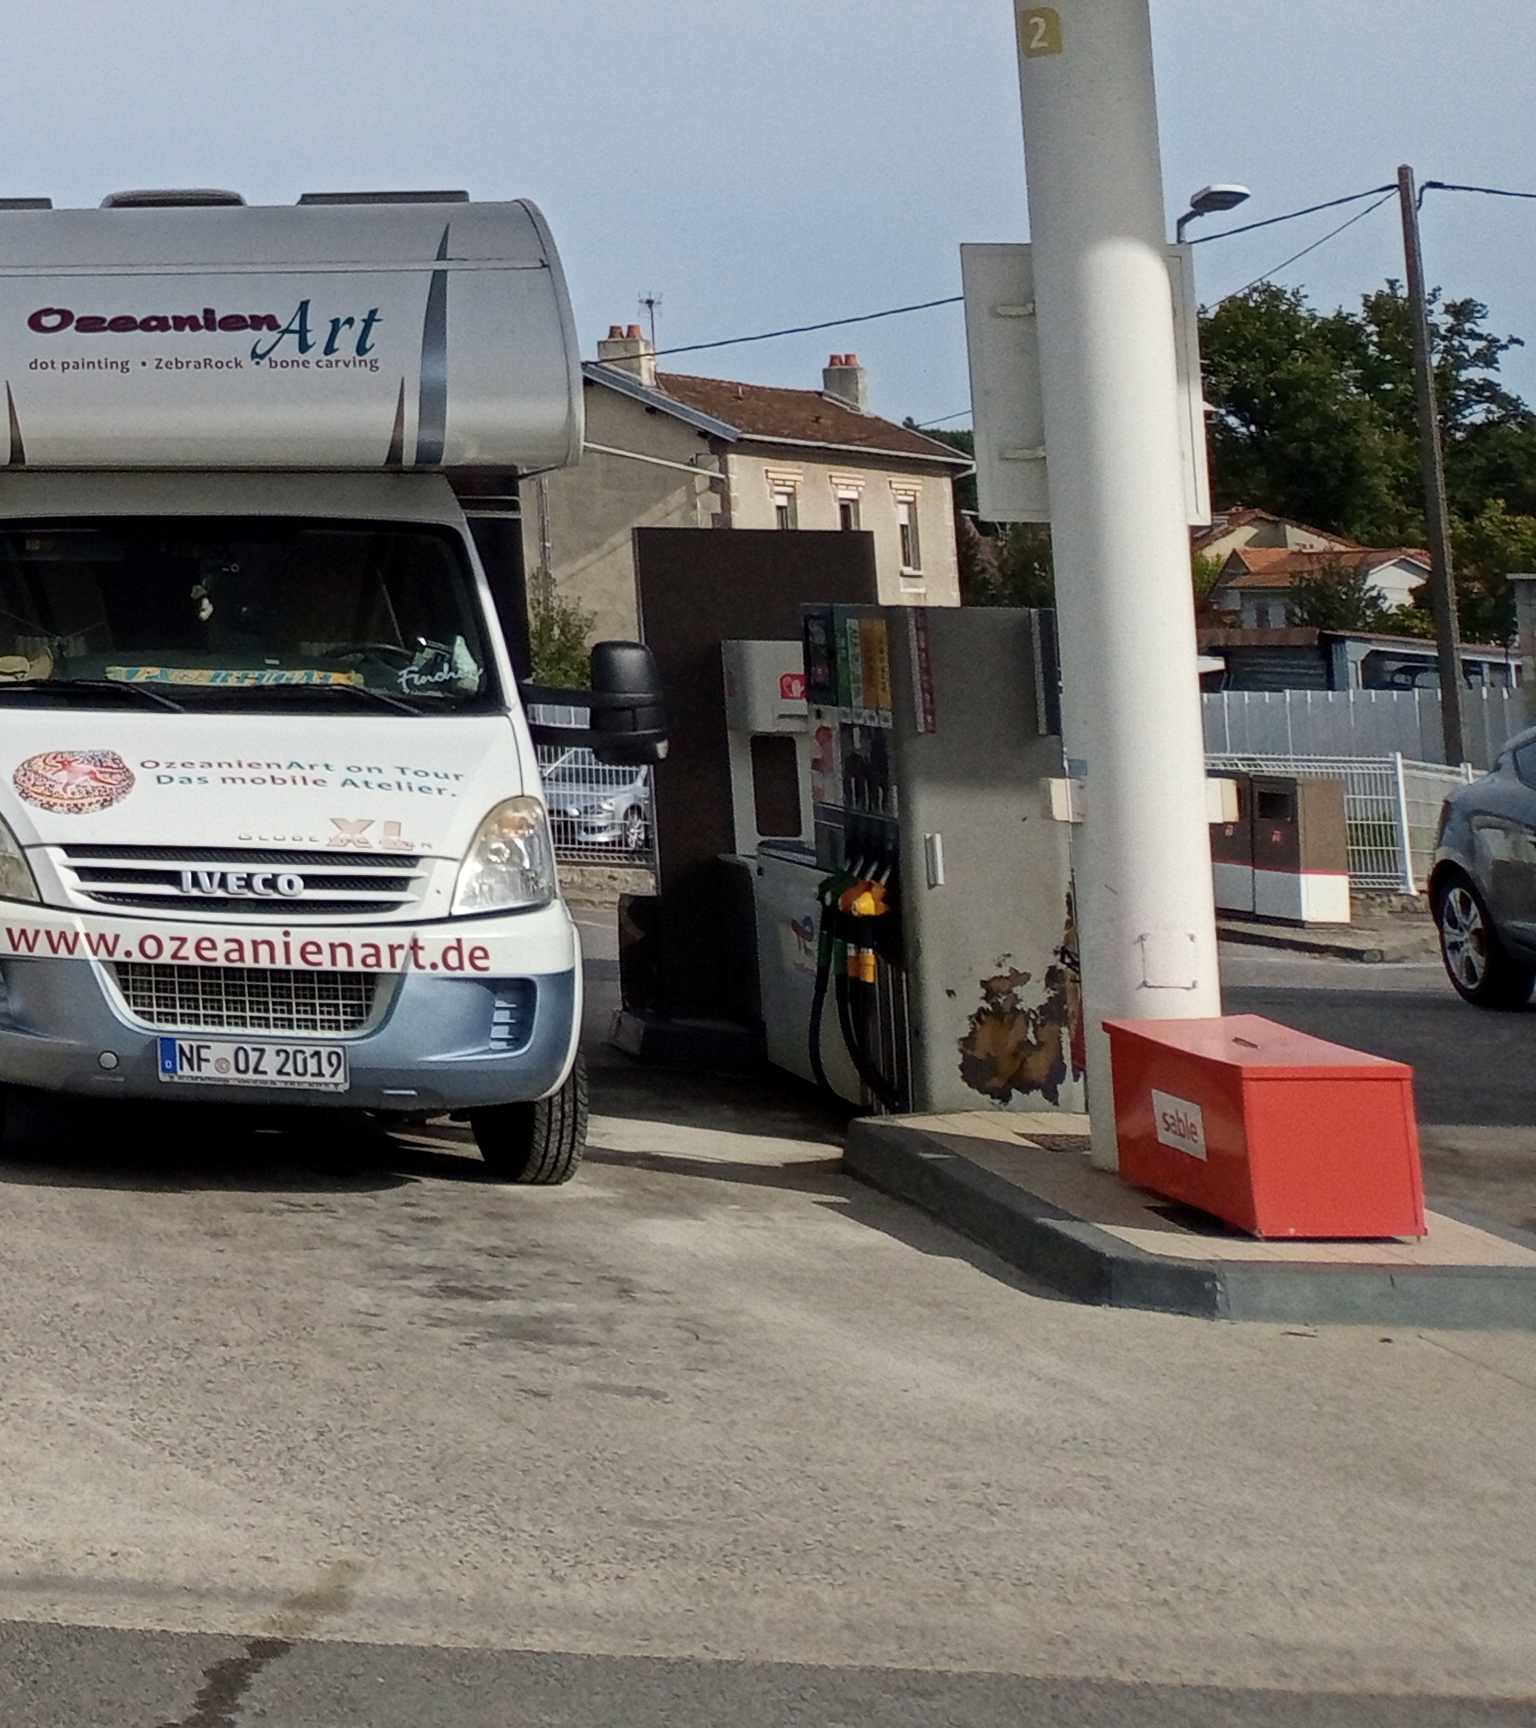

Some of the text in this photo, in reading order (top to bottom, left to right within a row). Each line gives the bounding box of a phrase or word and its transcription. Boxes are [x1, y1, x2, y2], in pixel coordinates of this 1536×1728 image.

[1028, 16, 1049, 50] 2
[29, 356, 381, 374] dot painting ZebraRock bone carving
[139, 759, 466, 782] OzeanienArt on Tour
[155, 773, 458, 798] Das mobile Atelier.
[180, 871, 305, 897] IVECO
[5, 926, 492, 973] www.ozeanienart.de
[178, 1043, 343, 1079] NF OZ 2019
[1161, 1108, 1199, 1144] sable
